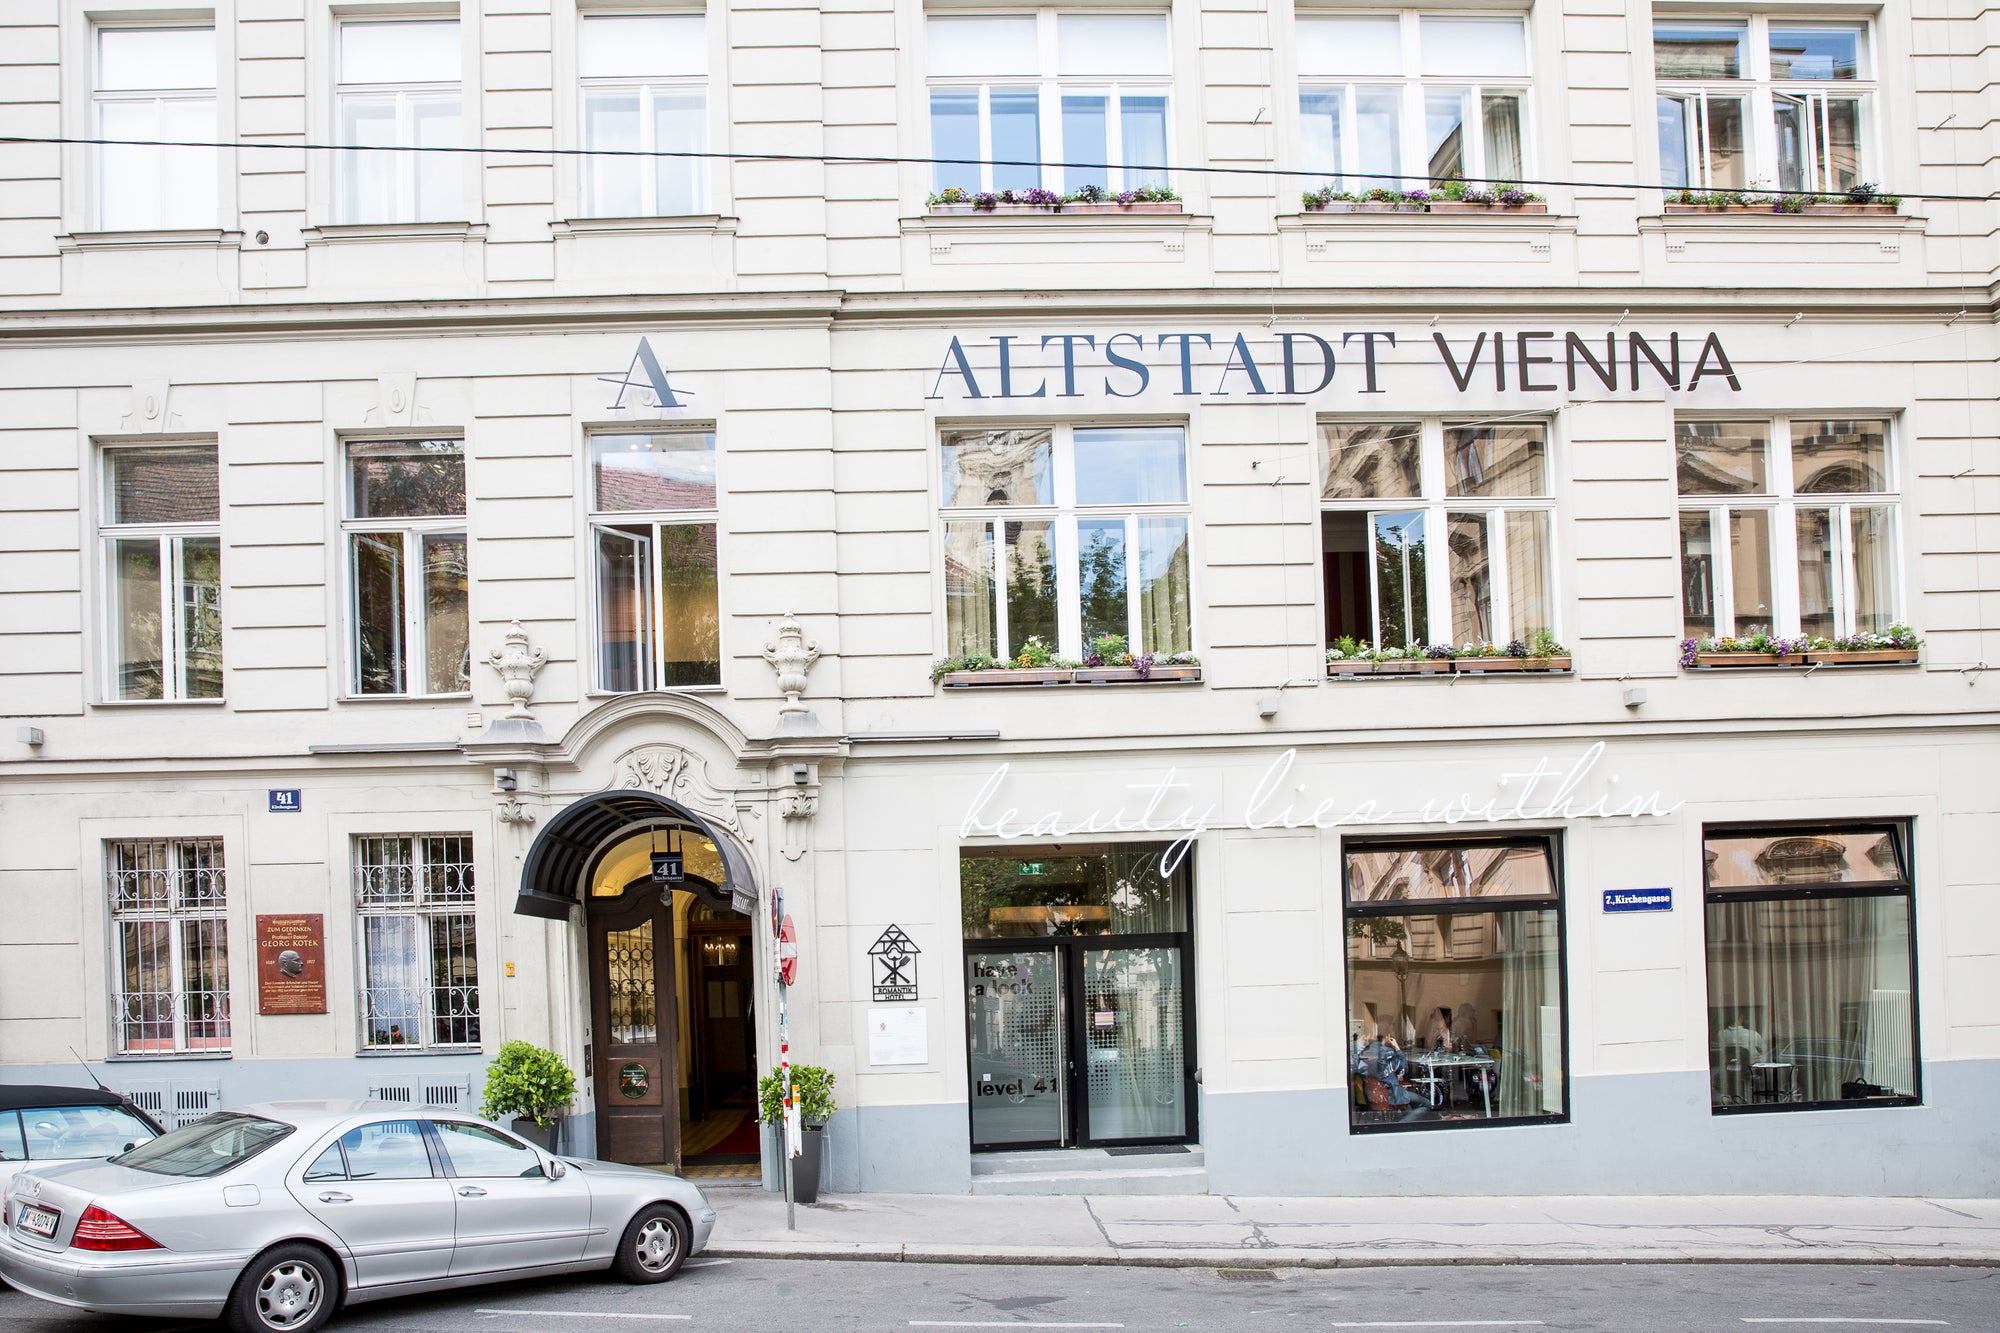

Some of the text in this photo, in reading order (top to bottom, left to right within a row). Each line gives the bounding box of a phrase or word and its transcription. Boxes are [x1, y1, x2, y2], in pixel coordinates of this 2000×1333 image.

[924, 331, 1742, 400] ALTSTADT VIENNA
[276, 792, 293, 805] 41
[958, 741, 1687, 879] beauty lies within
[657, 862, 677, 876] 41
[974, 962, 1018, 978] have
[975, 980, 1033, 995] a look
